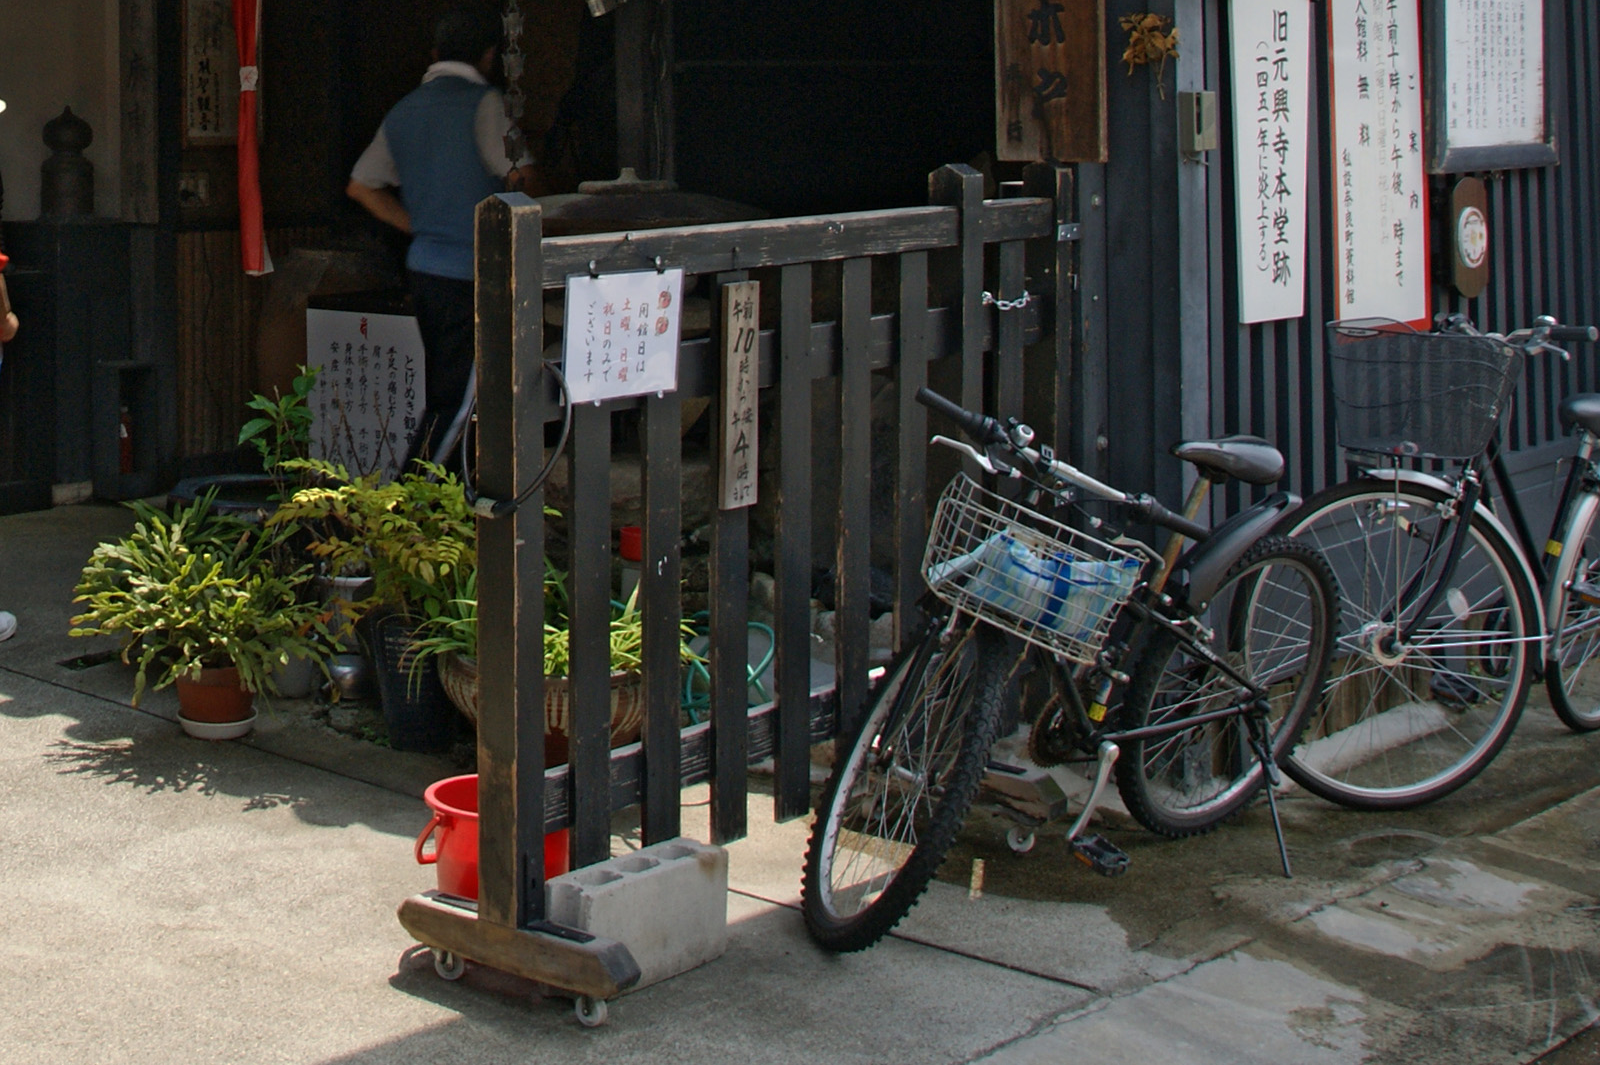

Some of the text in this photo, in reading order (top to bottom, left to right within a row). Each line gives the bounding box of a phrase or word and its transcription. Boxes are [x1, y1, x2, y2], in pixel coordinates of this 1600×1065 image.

[1272, 9, 1291, 287] 旧元興寺本堂跡
